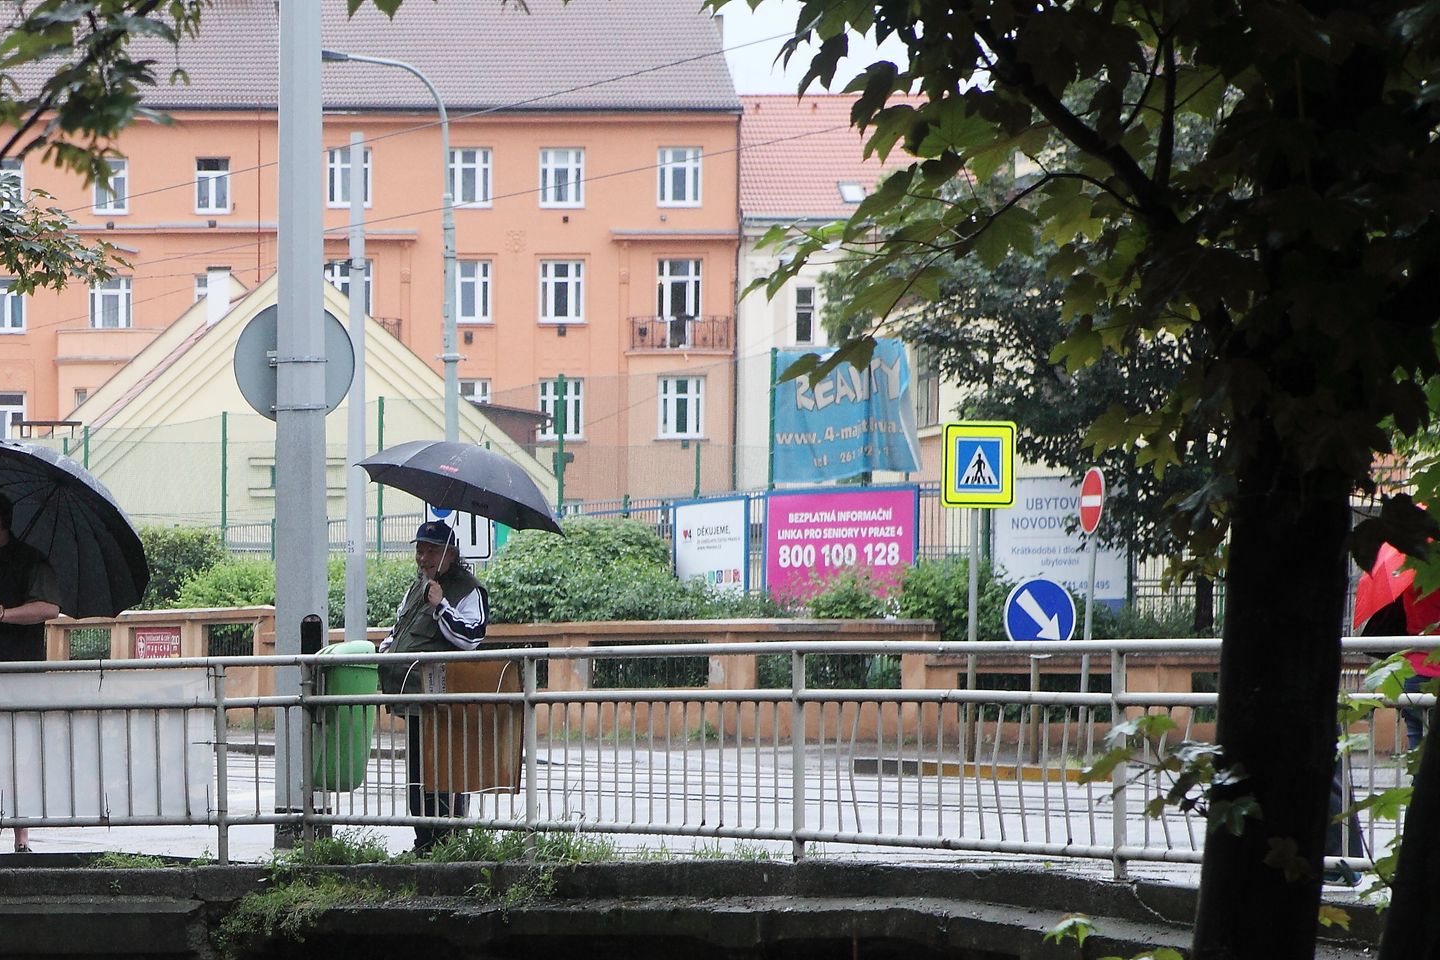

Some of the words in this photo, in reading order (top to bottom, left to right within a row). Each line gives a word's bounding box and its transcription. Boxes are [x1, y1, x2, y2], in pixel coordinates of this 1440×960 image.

[1026, 498, 1082, 511] UBYTOV
[788, 510, 836, 523] BEZPLATNÁ
[837, 508, 893, 522] INFORMAČNÍ
[696, 525, 731, 537] DĚKUJEME,
[777, 529, 803, 540] LINKA
[804, 528, 821, 540] PRO
[822, 527, 859, 539] SENIORY
[860, 527, 867, 538] V
[868, 526, 895, 538] PRAZE
[896, 526, 903, 537] 4
[778, 544, 816, 568] 800
[820, 543, 857, 568] 100
[863, 542, 900, 566] 128
